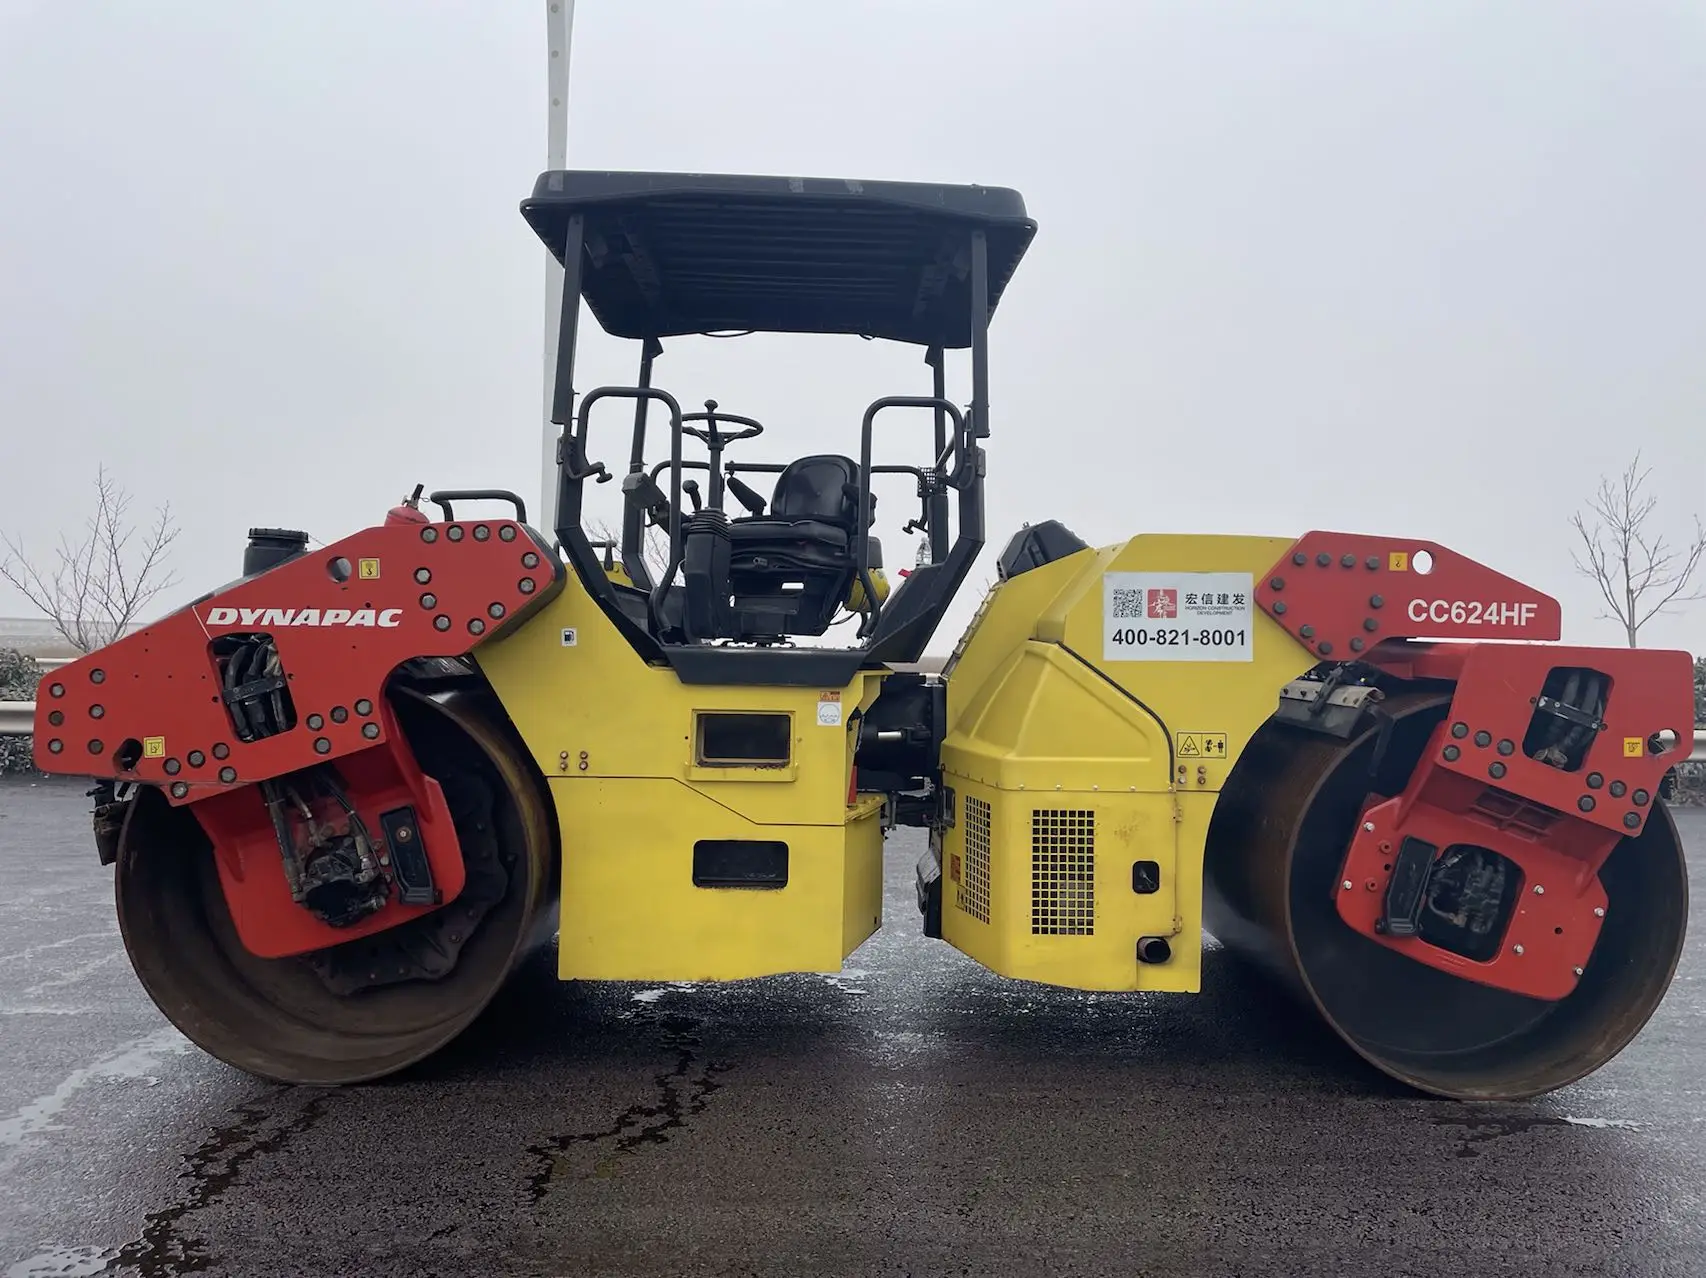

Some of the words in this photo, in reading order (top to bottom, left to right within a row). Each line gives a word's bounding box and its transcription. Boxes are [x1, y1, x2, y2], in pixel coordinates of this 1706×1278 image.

[1185, 593, 1245, 605] 宏信建发
[206, 607, 403, 628] DYNAPAC
[1407, 598, 1538, 626] CC624HF
[1112, 628, 1245, 646] 400-821-8001
